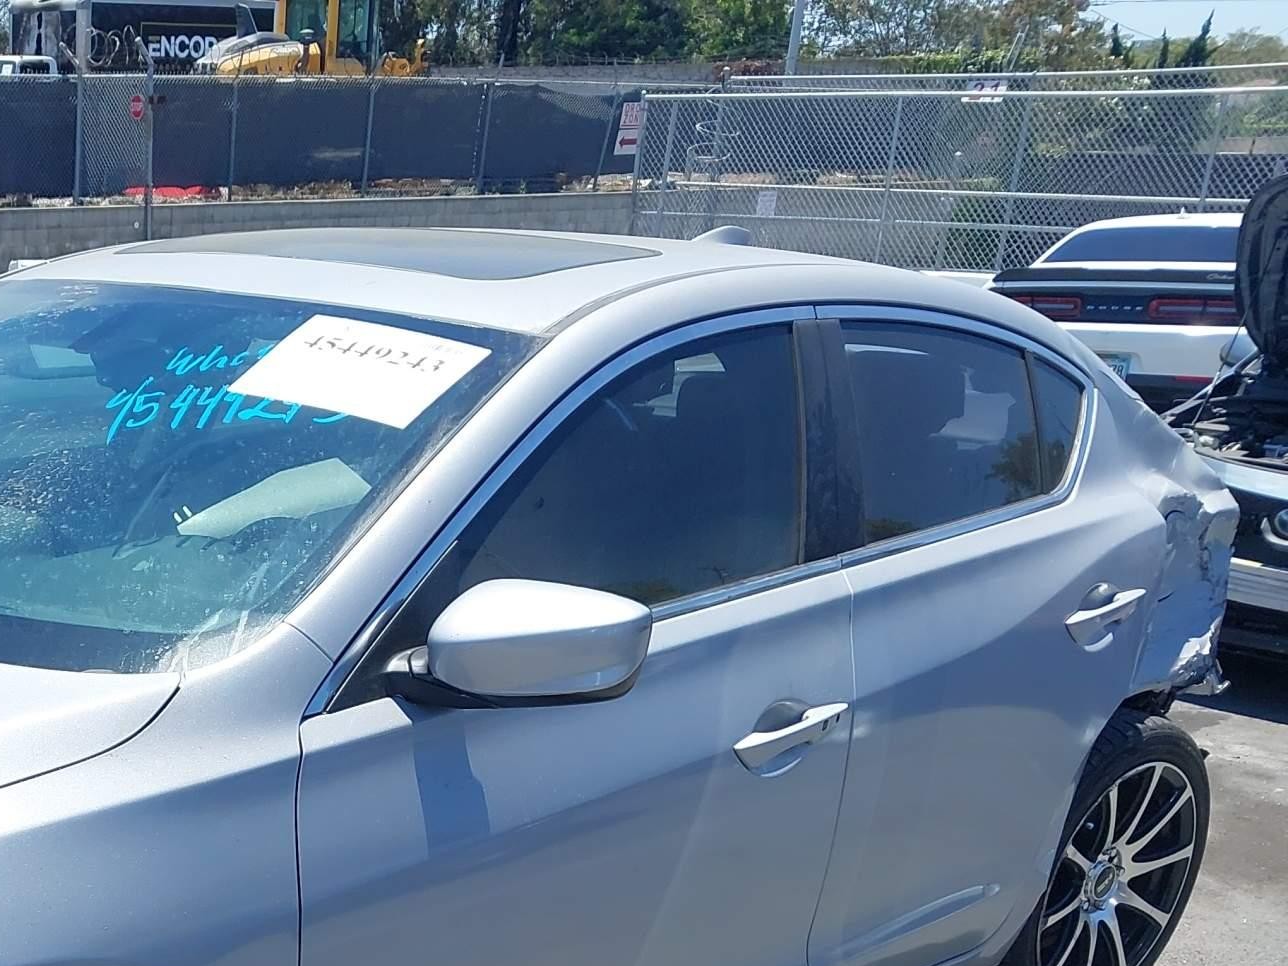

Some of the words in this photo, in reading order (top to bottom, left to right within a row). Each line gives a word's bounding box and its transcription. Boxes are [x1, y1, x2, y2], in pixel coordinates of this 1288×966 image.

[622, 113, 639, 124] ZON
[623, 103, 641, 113] DRO
[304, 336, 445, 371] 45449243
[105, 377, 346, 445] 454492
